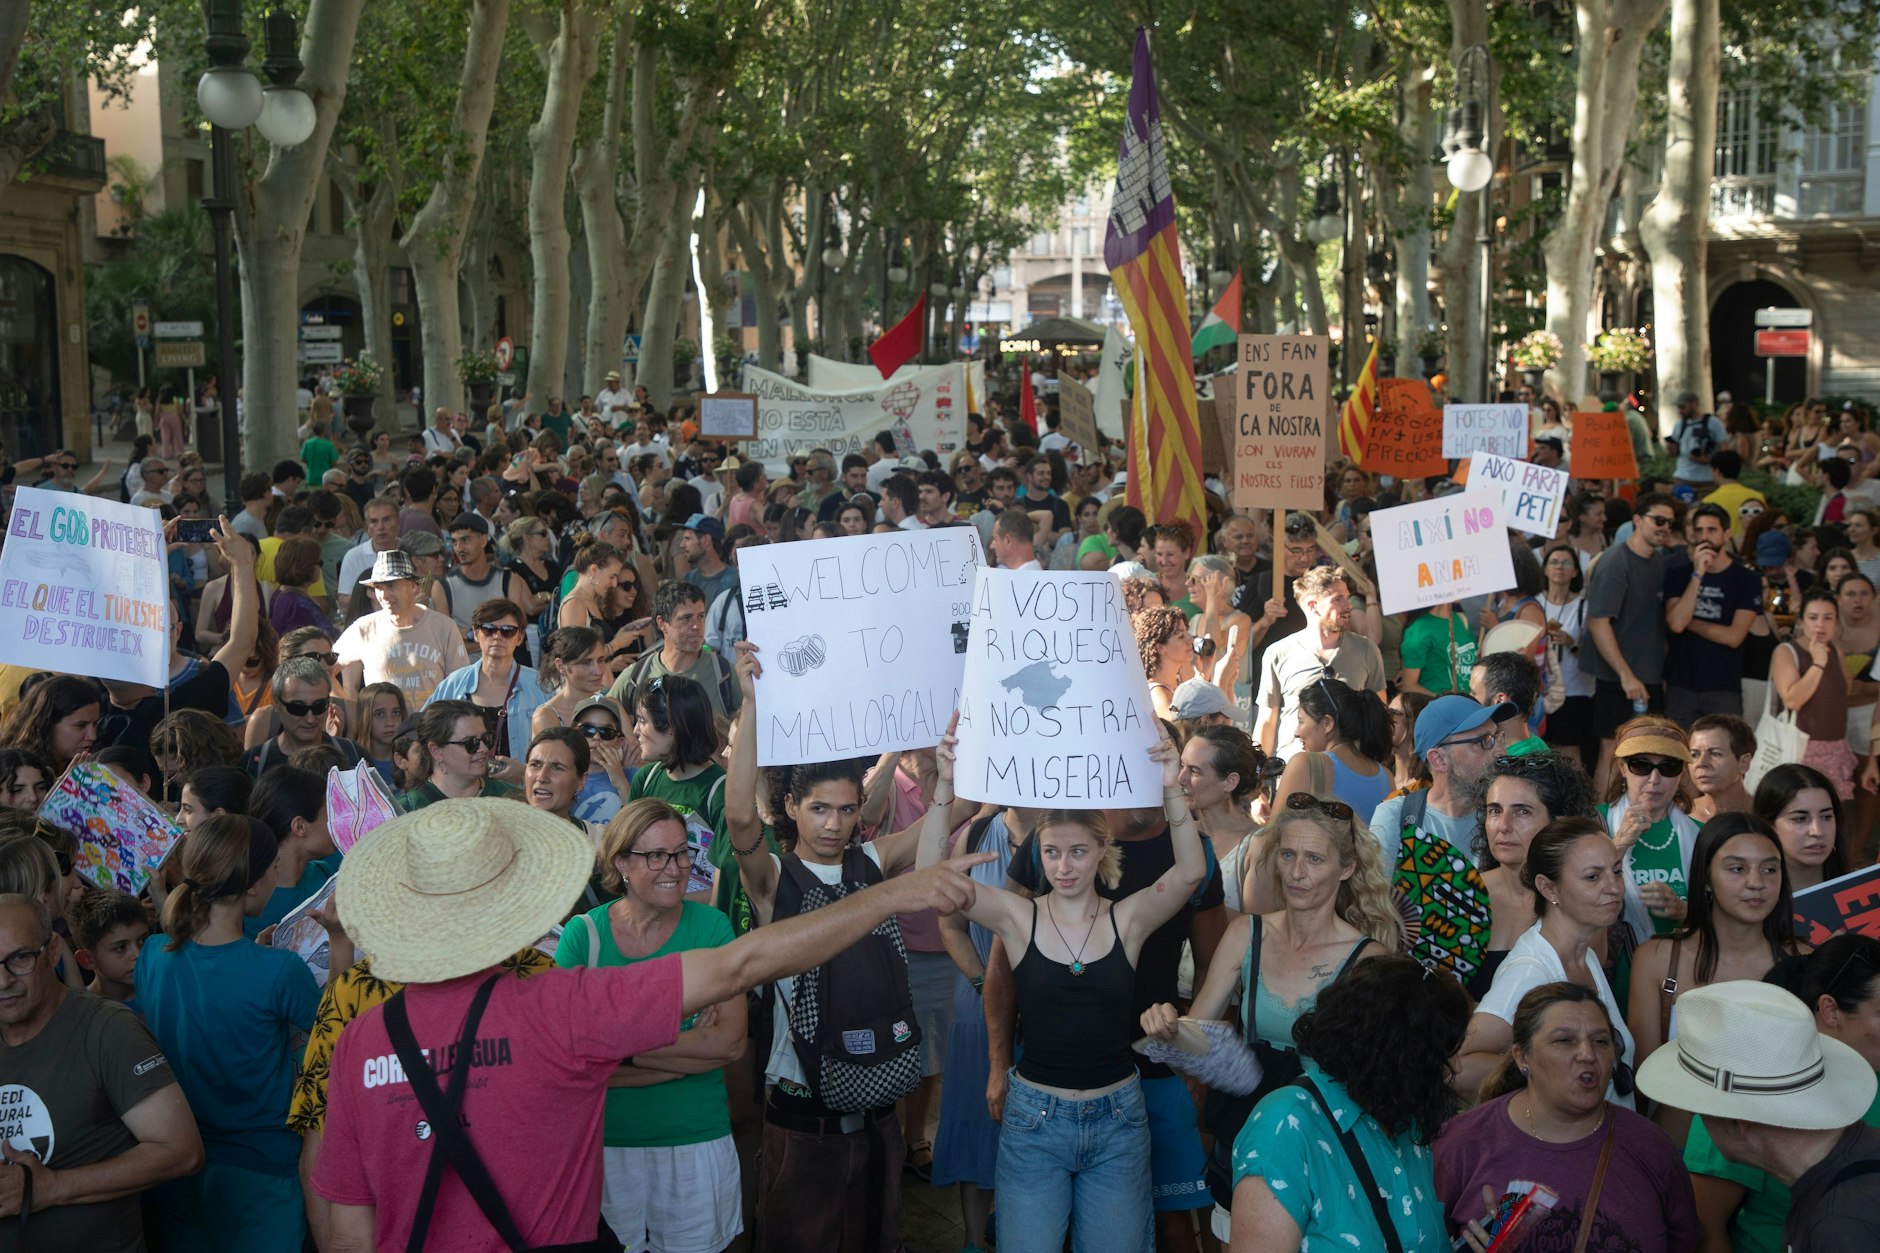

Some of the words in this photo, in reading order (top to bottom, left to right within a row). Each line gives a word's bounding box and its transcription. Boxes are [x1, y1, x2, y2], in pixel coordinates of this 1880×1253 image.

[1000, 341, 1031, 352] BORN
[1245, 343, 1270, 362] ENS
[1281, 342, 1317, 361] FAN
[1246, 370, 1314, 400] FORA
[789, 406, 845, 431] ESTÀ
[1270, 403, 1281, 412] DE
[1451, 409, 1497, 429] TOTES
[1502, 408, 1522, 429] NO
[1240, 413, 1261, 436] CA
[1268, 415, 1321, 437] NOSTRA
[1266, 461, 1283, 469] ELS
[1240, 472, 1282, 489] NOSTRES
[11, 508, 44, 540] EL
[50, 506, 89, 546] GOB
[91, 518, 162, 561] PROTEGEIX
[1399, 509, 1453, 550] AIXÍ
[1464, 507, 1494, 536] NO
[772, 539, 957, 603] WELCOME
[1417, 555, 1480, 589] ANAM
[1, 579, 29, 609] EL
[32, 583, 74, 615] QUE
[76, 589, 99, 620] EL
[104, 593, 165, 632] TURISME
[23, 615, 144, 657] DESTRUEIX
[848, 624, 903, 667] TO
[990, 697, 1141, 738] NOSTRA
[985, 753, 1133, 799] MISERIA
[1, 1089, 24, 1104] EDI
